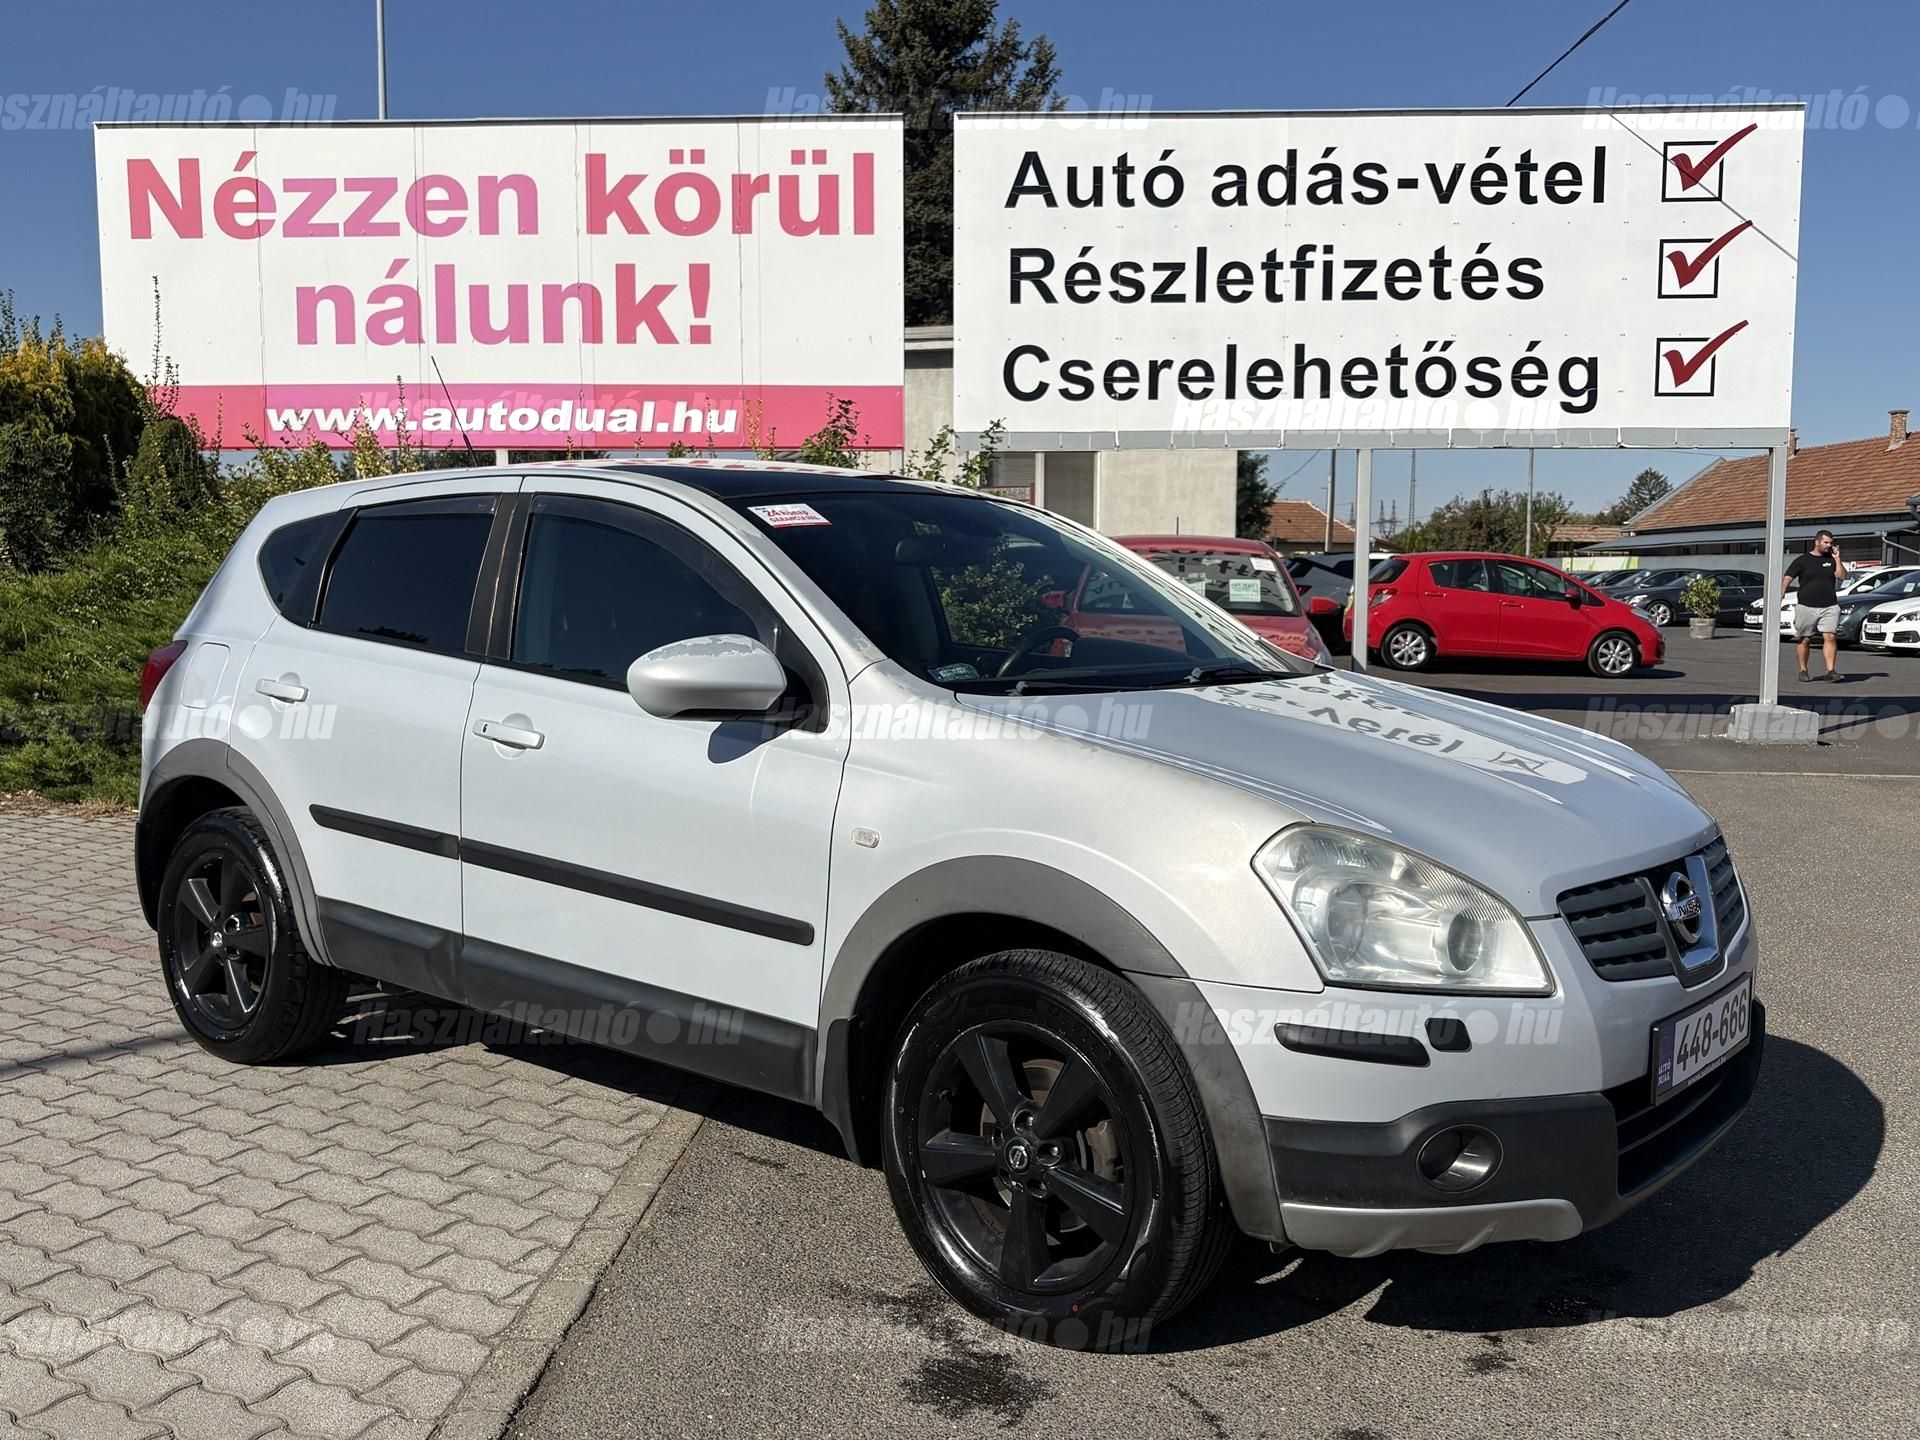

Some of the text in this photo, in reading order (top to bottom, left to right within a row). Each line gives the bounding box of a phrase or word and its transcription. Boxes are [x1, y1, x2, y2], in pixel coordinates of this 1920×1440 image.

[127, 149, 875, 241] Nézzen körül
[1005, 146, 1607, 208] Autó adás-vétel
[296, 258, 712, 346] nálunk!
[1009, 242, 1545, 304] Részletfizetés
[1003, 340, 1599, 414] Cserelehetőség
[266, 400, 738, 433] www.autodual.hu
[1677, 988, 1747, 1071] 448-666
